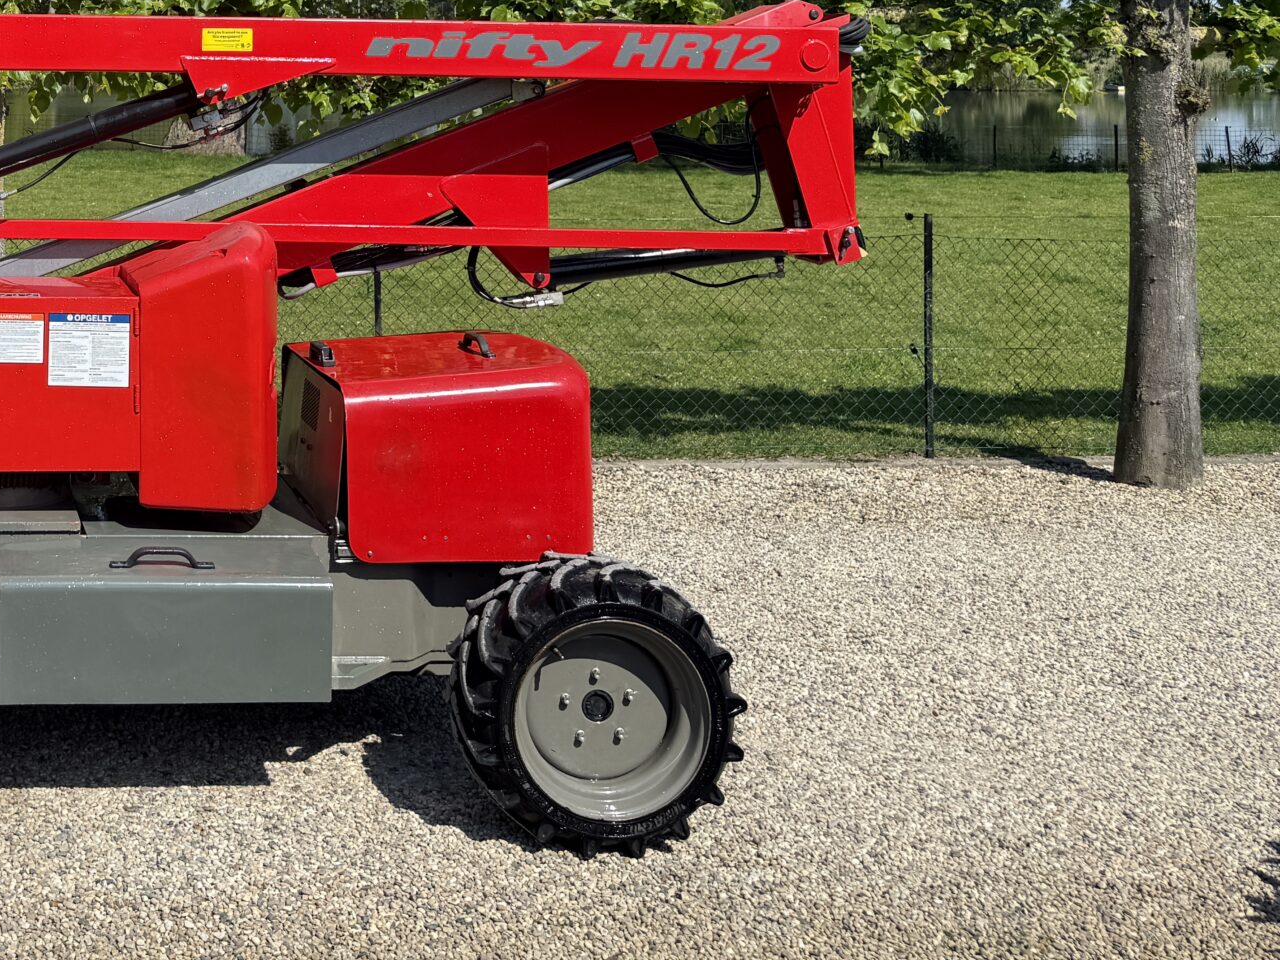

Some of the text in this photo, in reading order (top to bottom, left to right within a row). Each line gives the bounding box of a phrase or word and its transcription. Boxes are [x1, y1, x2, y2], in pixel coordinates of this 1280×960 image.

[366, 31, 781, 71] nifty HR12
[74, 314, 113, 322] OPGELET
